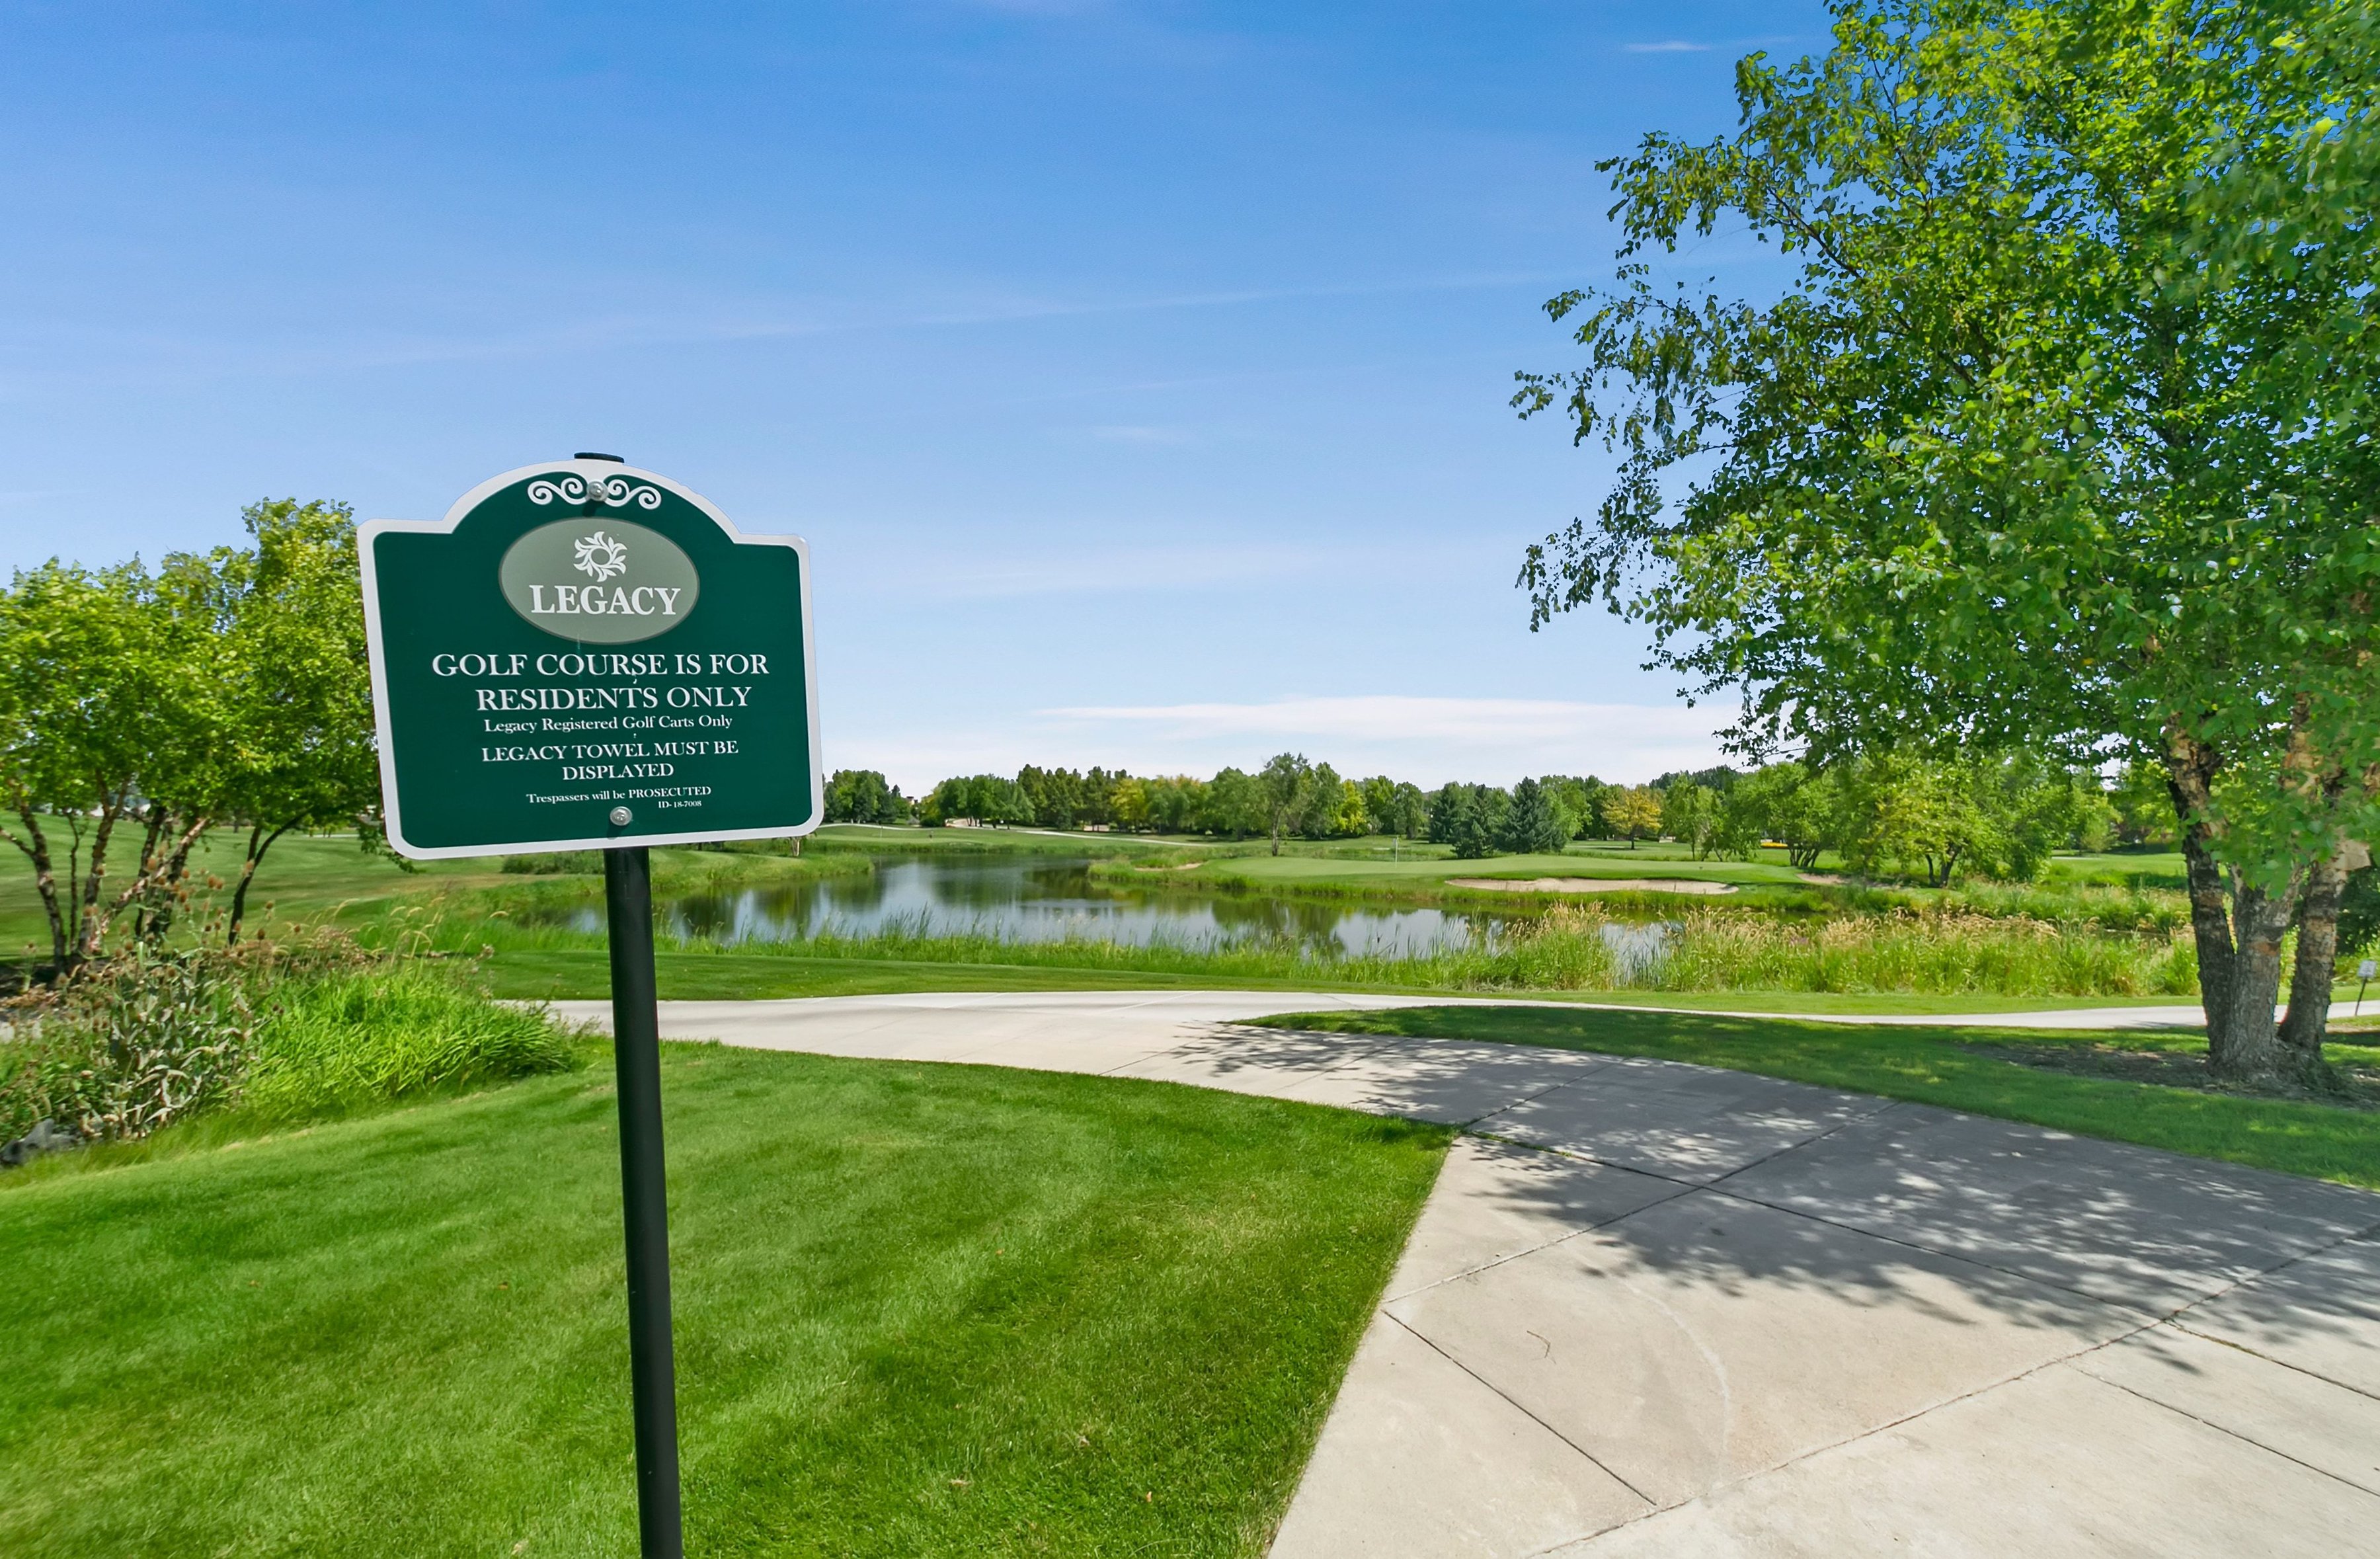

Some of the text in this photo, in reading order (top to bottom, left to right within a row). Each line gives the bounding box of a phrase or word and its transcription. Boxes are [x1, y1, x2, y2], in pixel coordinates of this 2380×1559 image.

[529, 584, 681, 616] LEGACY
[432, 653, 770, 676] GOLF COURSE IS FOR
[475, 686, 752, 711] RESIDENTS ONLY
[484, 714, 733, 734] Legacy Registered Golf Carts Only
[481, 740, 739, 762] LEGACY TOWEL MUST BE
[562, 763, 674, 780] DISPLAYED
[526, 786, 711, 805] Trespassers will be PROSECUTED
